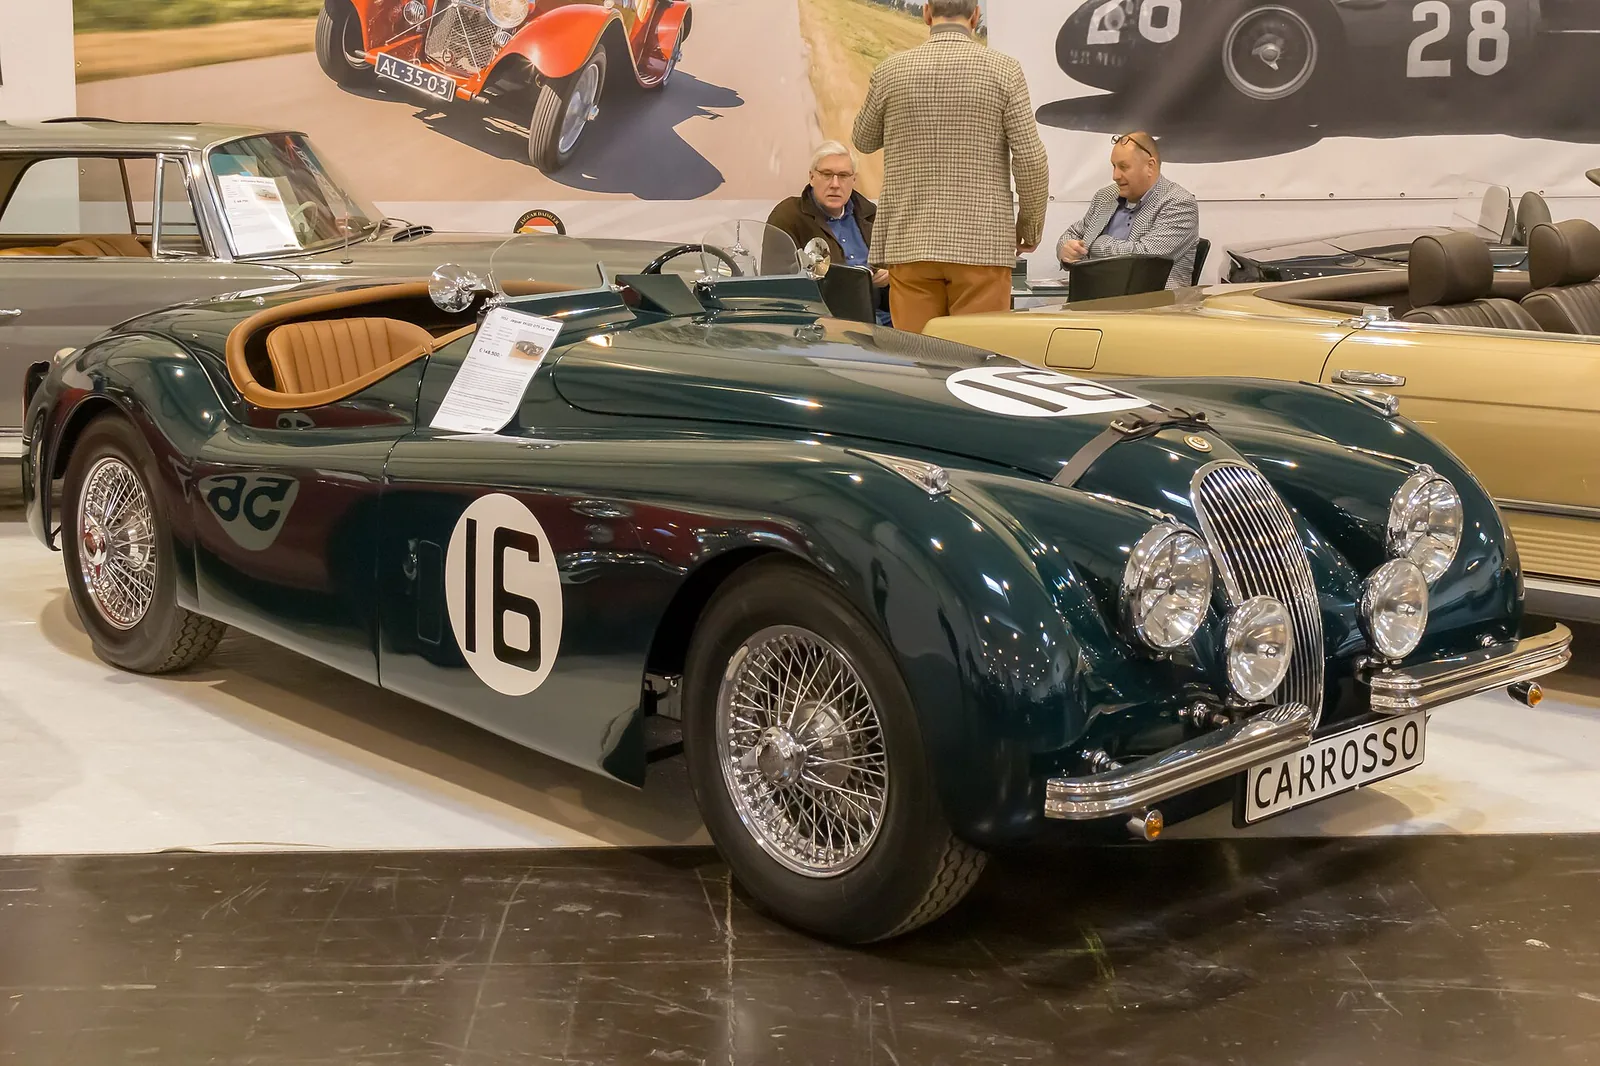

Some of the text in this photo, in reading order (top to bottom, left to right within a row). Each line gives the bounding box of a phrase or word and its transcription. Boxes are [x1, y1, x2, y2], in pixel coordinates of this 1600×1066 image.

[1406, 0, 1510, 77] 28
[954, 371, 1138, 412] 16
[465, 517, 542, 672] 16
[1254, 720, 1418, 809] CARROSSO
